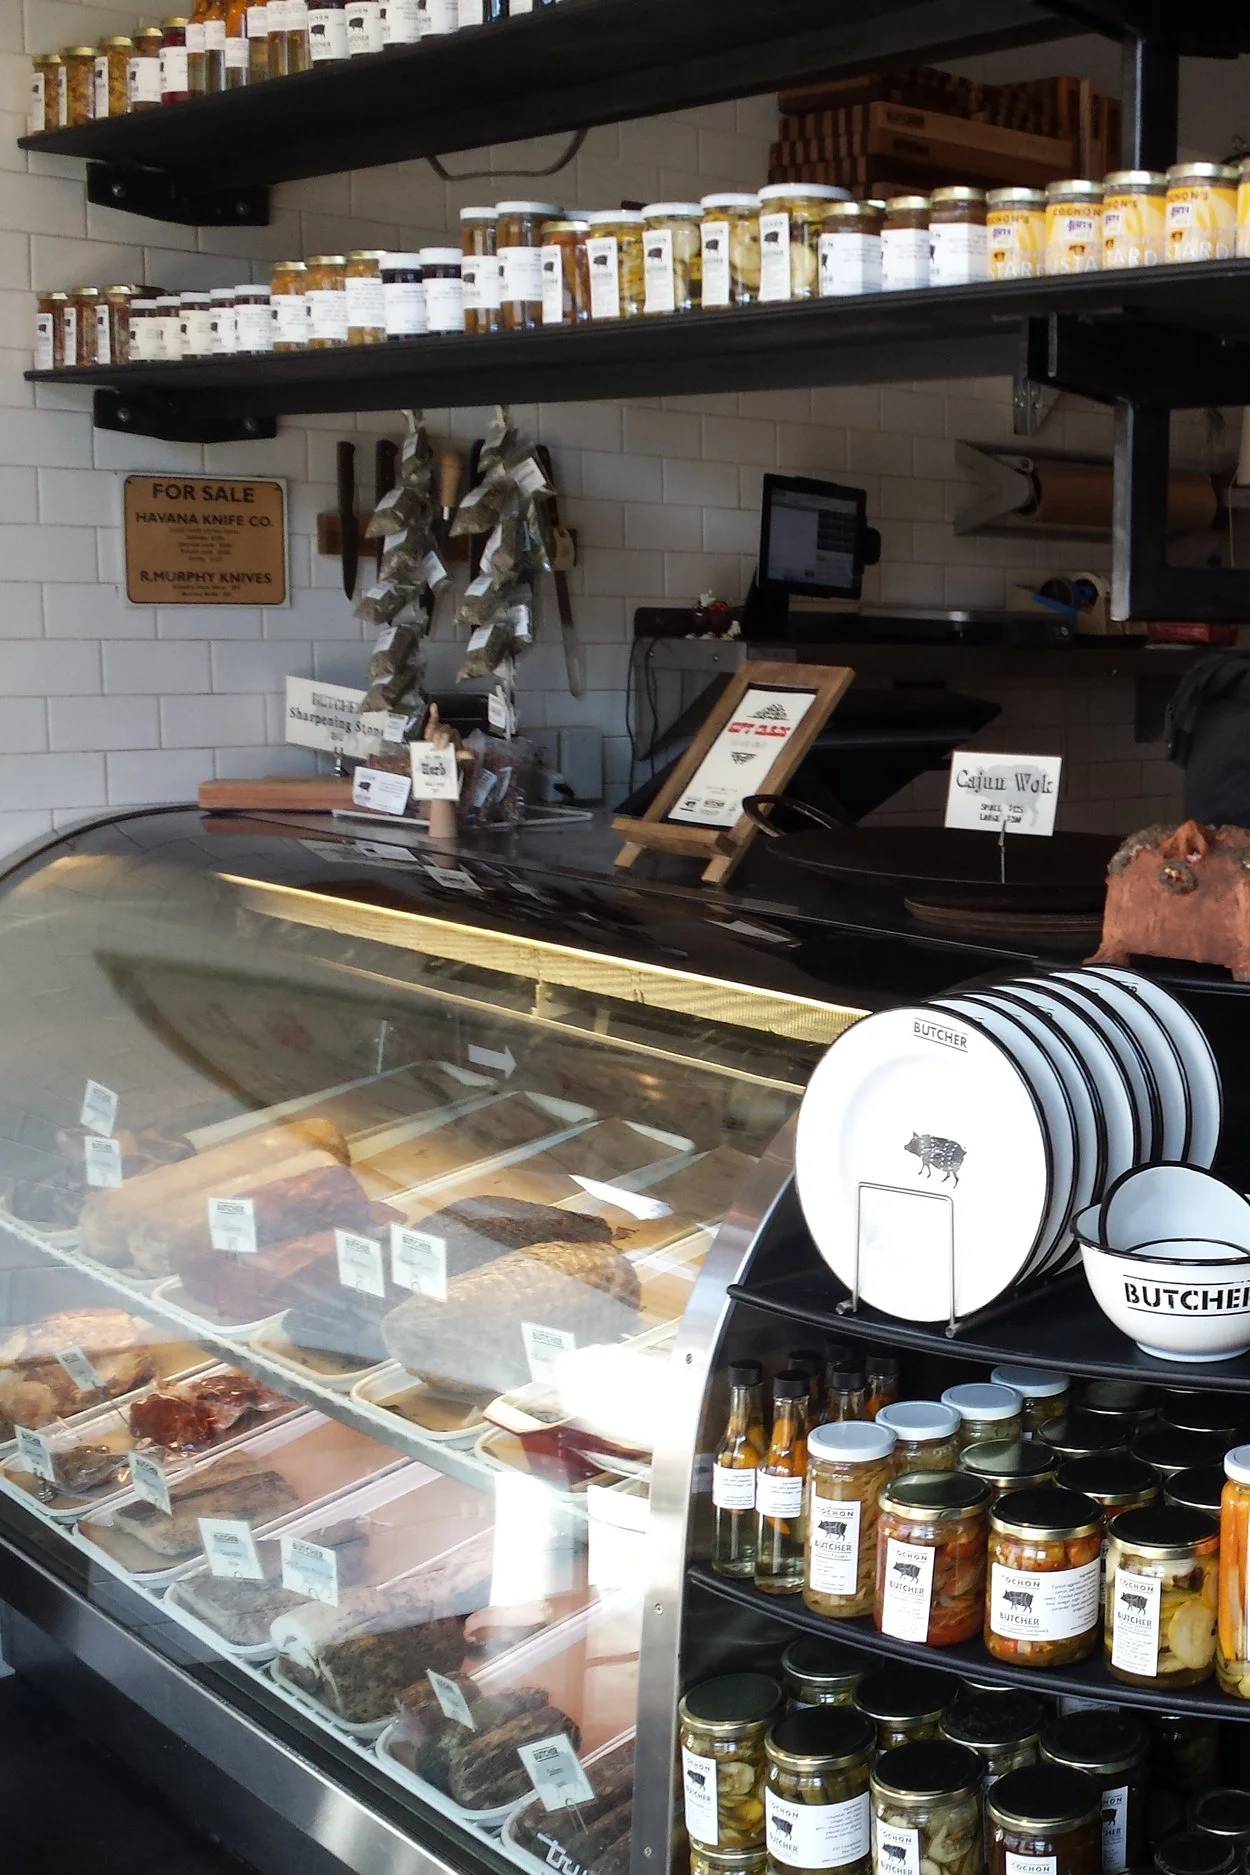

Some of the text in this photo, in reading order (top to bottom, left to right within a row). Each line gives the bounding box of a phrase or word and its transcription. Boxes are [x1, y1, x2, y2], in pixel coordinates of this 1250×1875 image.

[1053, 207, 1101, 218] COCHON
[152, 482, 256, 504] FOR SALE
[135, 511, 273, 528] HAVANA KNIFE CO.
[139, 570, 273, 585] R.MURPHY KNIVES
[289, 706, 352, 734] Sharpening
[956, 768, 1054, 794] Cajun Wok
[913, 1020, 969, 1049] BUTCHER
[817, 1506, 854, 1518] OCHON
[814, 1540, 853, 1552] BUTCHER
[893, 1550, 928, 1562] OCHON
[889, 1580, 925, 1595] BUTCHER
[1001, 1575, 1041, 1588] OCHON
[1119, 1578, 1154, 1592] OCHON
[999, 1612, 1040, 1626] BUTCHER
[1117, 1612, 1153, 1627] BUTCHER
[880, 1828, 913, 1844] OCHON
[1011, 1861, 1050, 1873] COCHON
